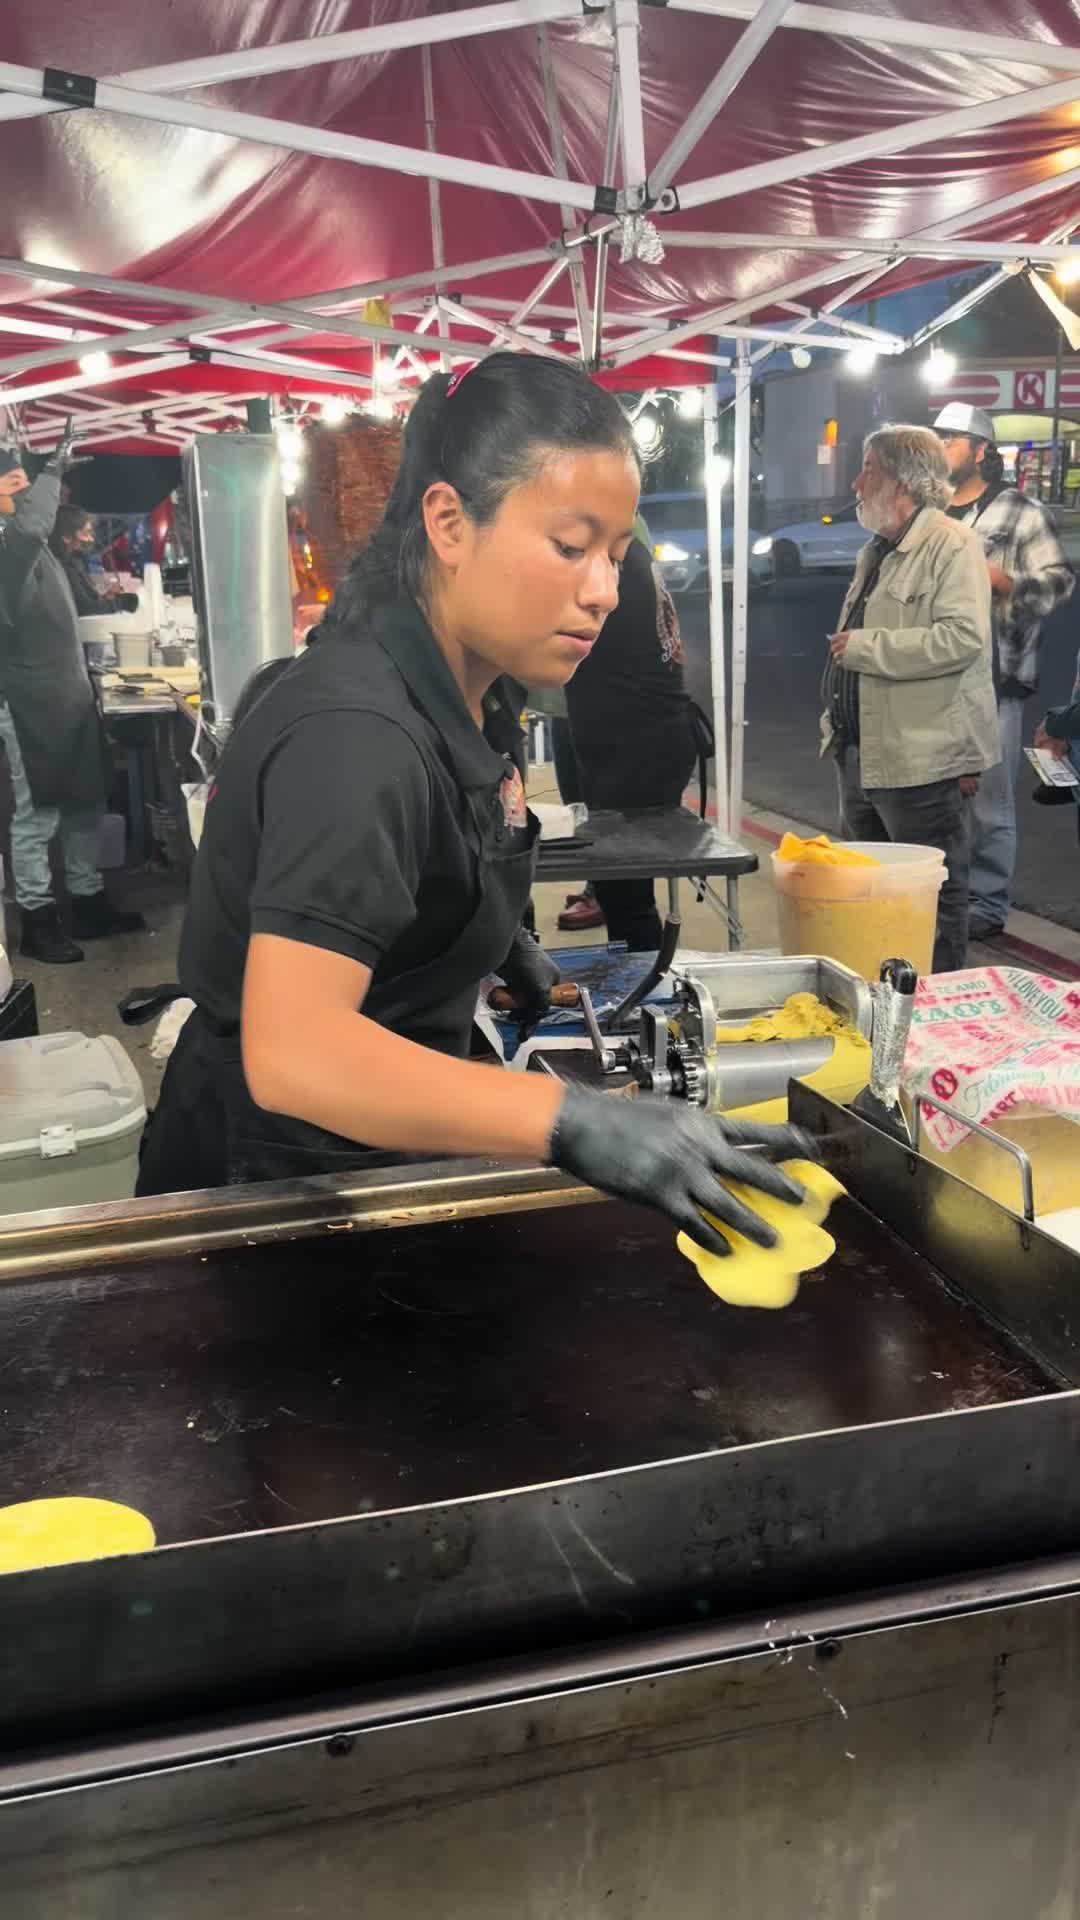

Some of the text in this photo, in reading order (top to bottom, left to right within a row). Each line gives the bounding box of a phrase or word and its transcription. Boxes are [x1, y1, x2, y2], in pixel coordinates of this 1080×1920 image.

[1017, 373, 1043, 405] K
[1012, 976, 1041, 1004] LOVE
[1034, 992, 1065, 1020] YOU
